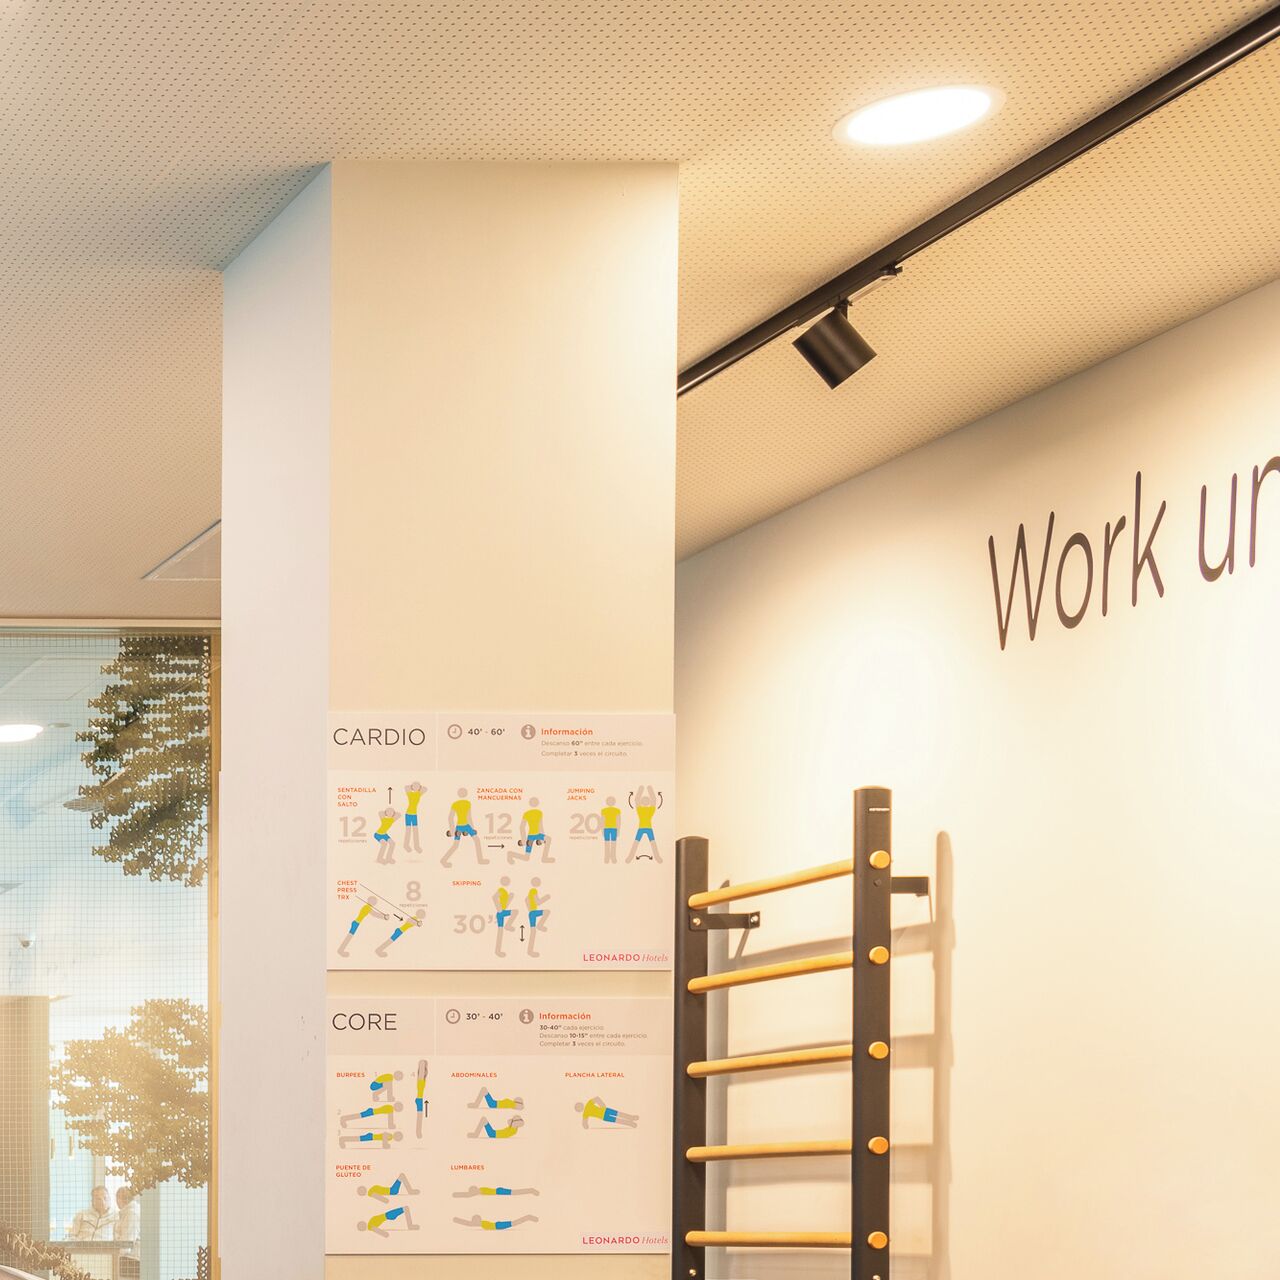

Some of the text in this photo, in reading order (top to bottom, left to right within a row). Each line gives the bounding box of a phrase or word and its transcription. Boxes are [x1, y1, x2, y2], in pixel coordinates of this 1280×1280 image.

[987, 471, 1167, 651] Work
[333, 728, 426, 746] CARDIO
[541, 727, 594, 736] Información
[541, 750, 573, 758] Completar
[339, 816, 368, 837] 12
[484, 812, 513, 834] 12
[569, 813, 603, 834] 20
[406, 880, 422, 902] 8
[583, 953, 669, 963] LEONARDO Hotels
[332, 1013, 398, 1031] CORE
[539, 1012, 591, 1020] Información
[582, 1236, 669, 1245] LEONARDO Hotels
